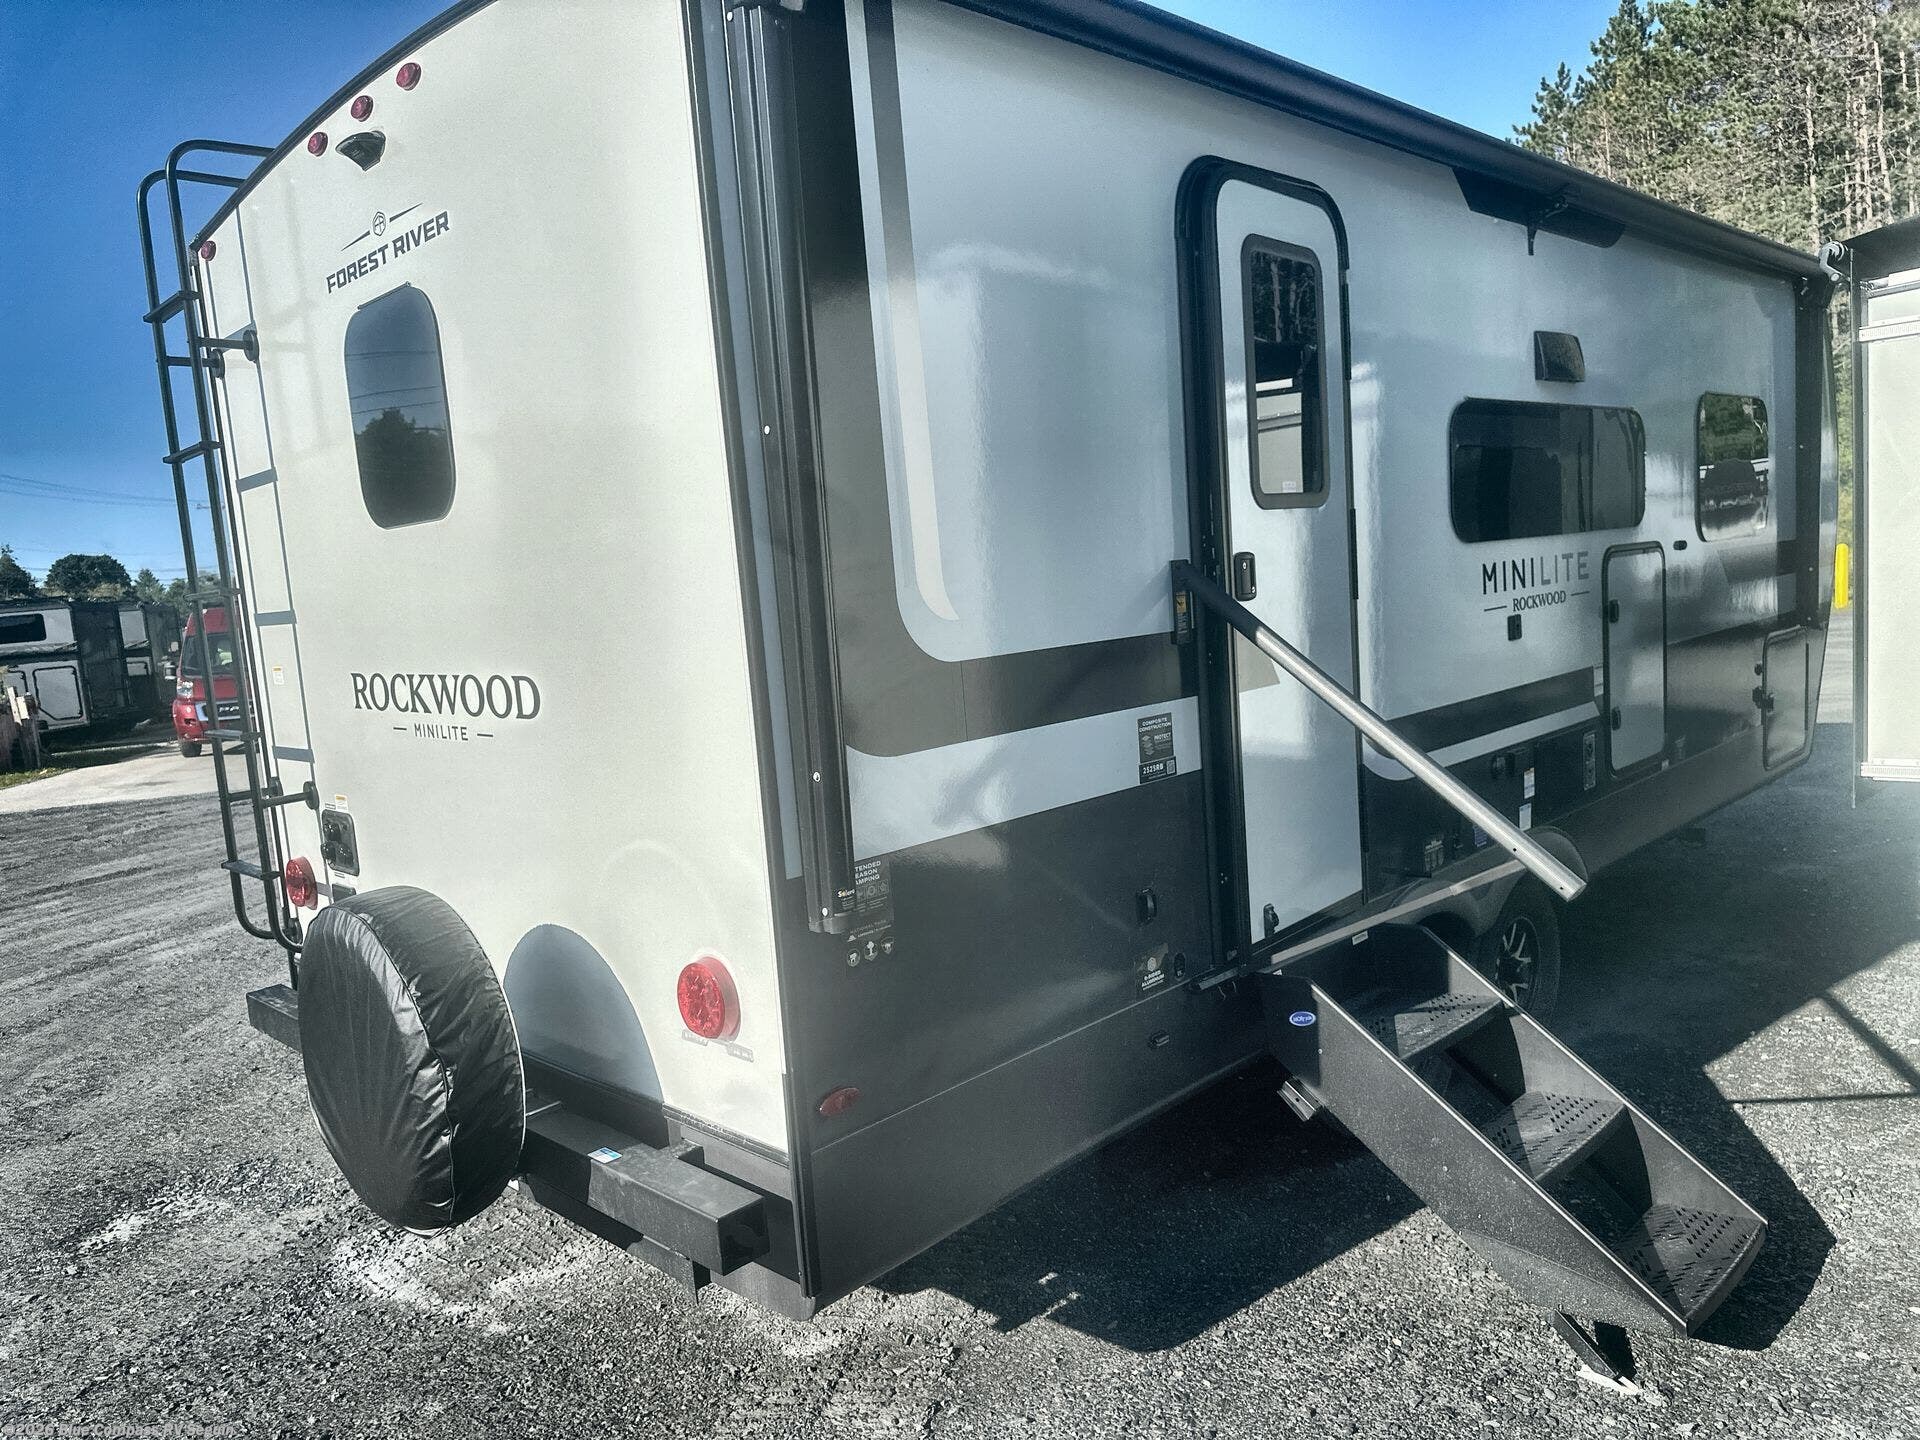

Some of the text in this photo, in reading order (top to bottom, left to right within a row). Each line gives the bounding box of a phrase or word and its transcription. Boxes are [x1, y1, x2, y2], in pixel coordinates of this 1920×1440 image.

[326, 210, 450, 294] FOREST RIVER
[1482, 551, 1590, 595] MINILITE
[1513, 590, 1567, 612] ROCKWOOD
[350, 672, 541, 720] ROCKWOOD
[414, 723, 469, 741] MINILITE
[1139, 722, 1171, 732] CONSTRUCTION
[1142, 717, 1167, 727] COMPOSITE
